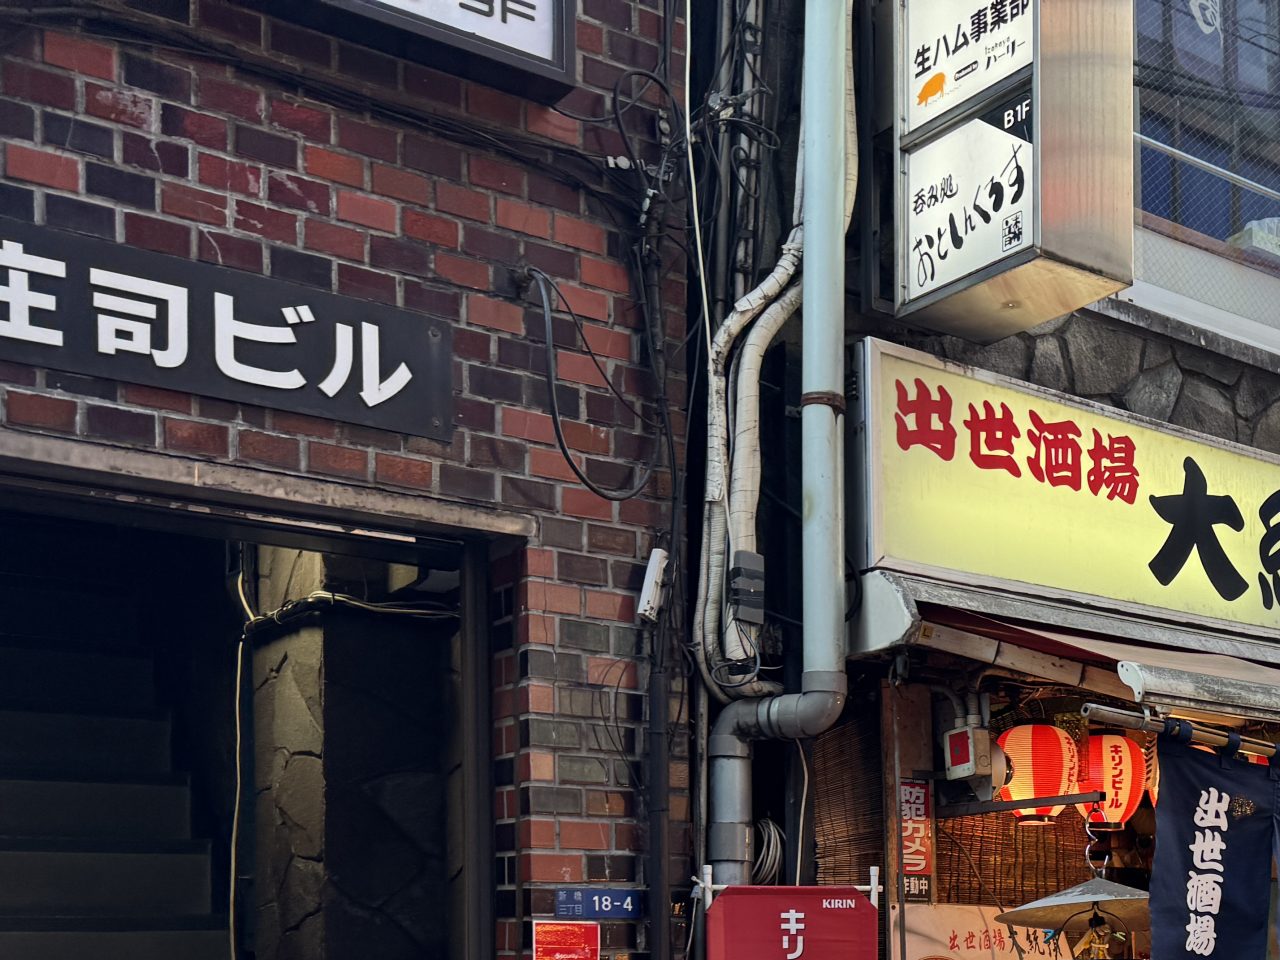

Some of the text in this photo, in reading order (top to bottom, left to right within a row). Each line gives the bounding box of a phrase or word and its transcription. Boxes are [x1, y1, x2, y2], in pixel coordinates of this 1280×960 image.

[1004, 99, 1031, 130] B1F
[913, 174, 958, 216] 呑み処
[895, 378, 1140, 504] 出世酒場
[1109, 744, 1123, 809] キリンビール
[901, 786, 926, 871] 防犯カメラ
[1186, 787, 1231, 956] 出世酒場
[559, 904, 583, 915] 三丁目
[592, 895, 633, 912] 18-4
[822, 899, 855, 908] KIRIN
[949, 929, 1005, 951] 出世酒場
